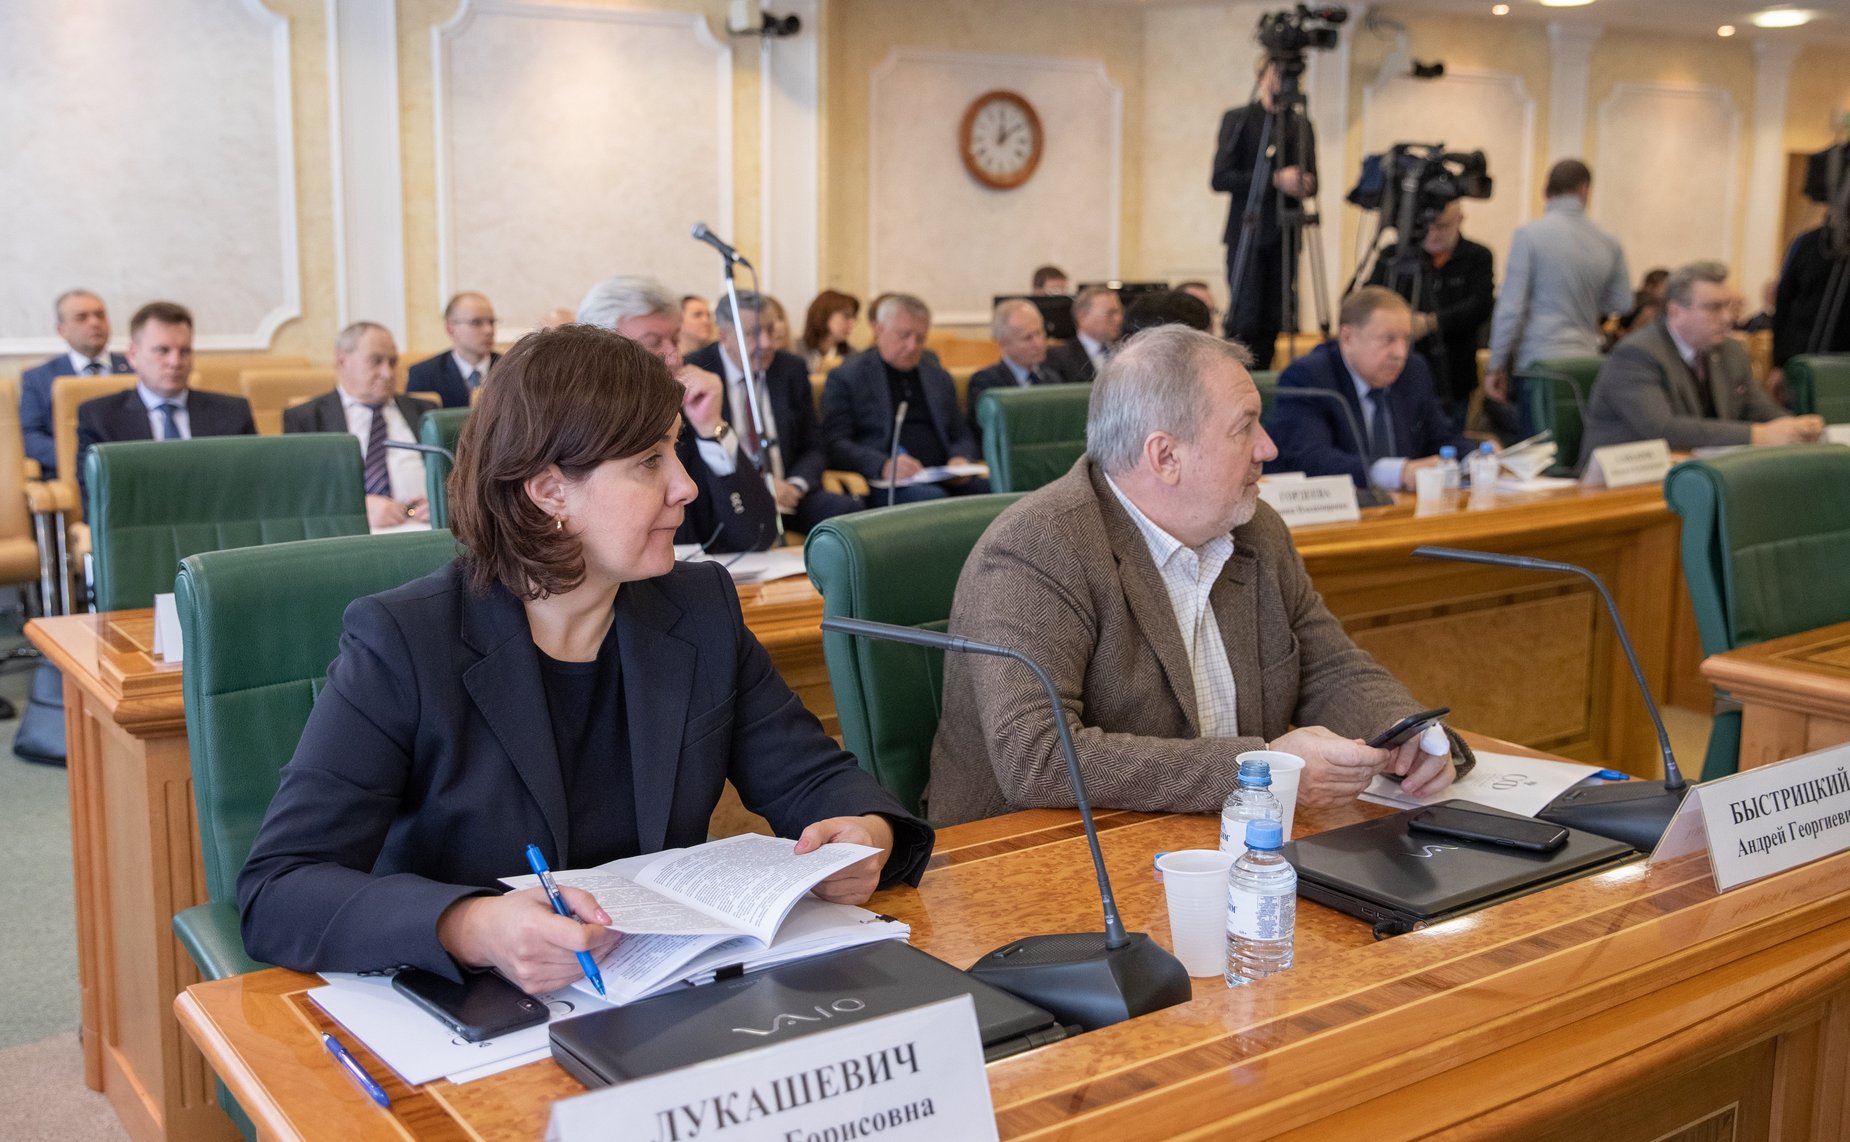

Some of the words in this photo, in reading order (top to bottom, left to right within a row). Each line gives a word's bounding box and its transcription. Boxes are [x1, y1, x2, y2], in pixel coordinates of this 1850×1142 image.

[1730, 766, 1850, 825] БЫСТРИЦКИЙ
[1738, 826, 1787, 858] Андрей
[731, 998, 865, 1036] VAIO
[651, 1041, 921, 1142] ЛУКАШЕВИЧ
